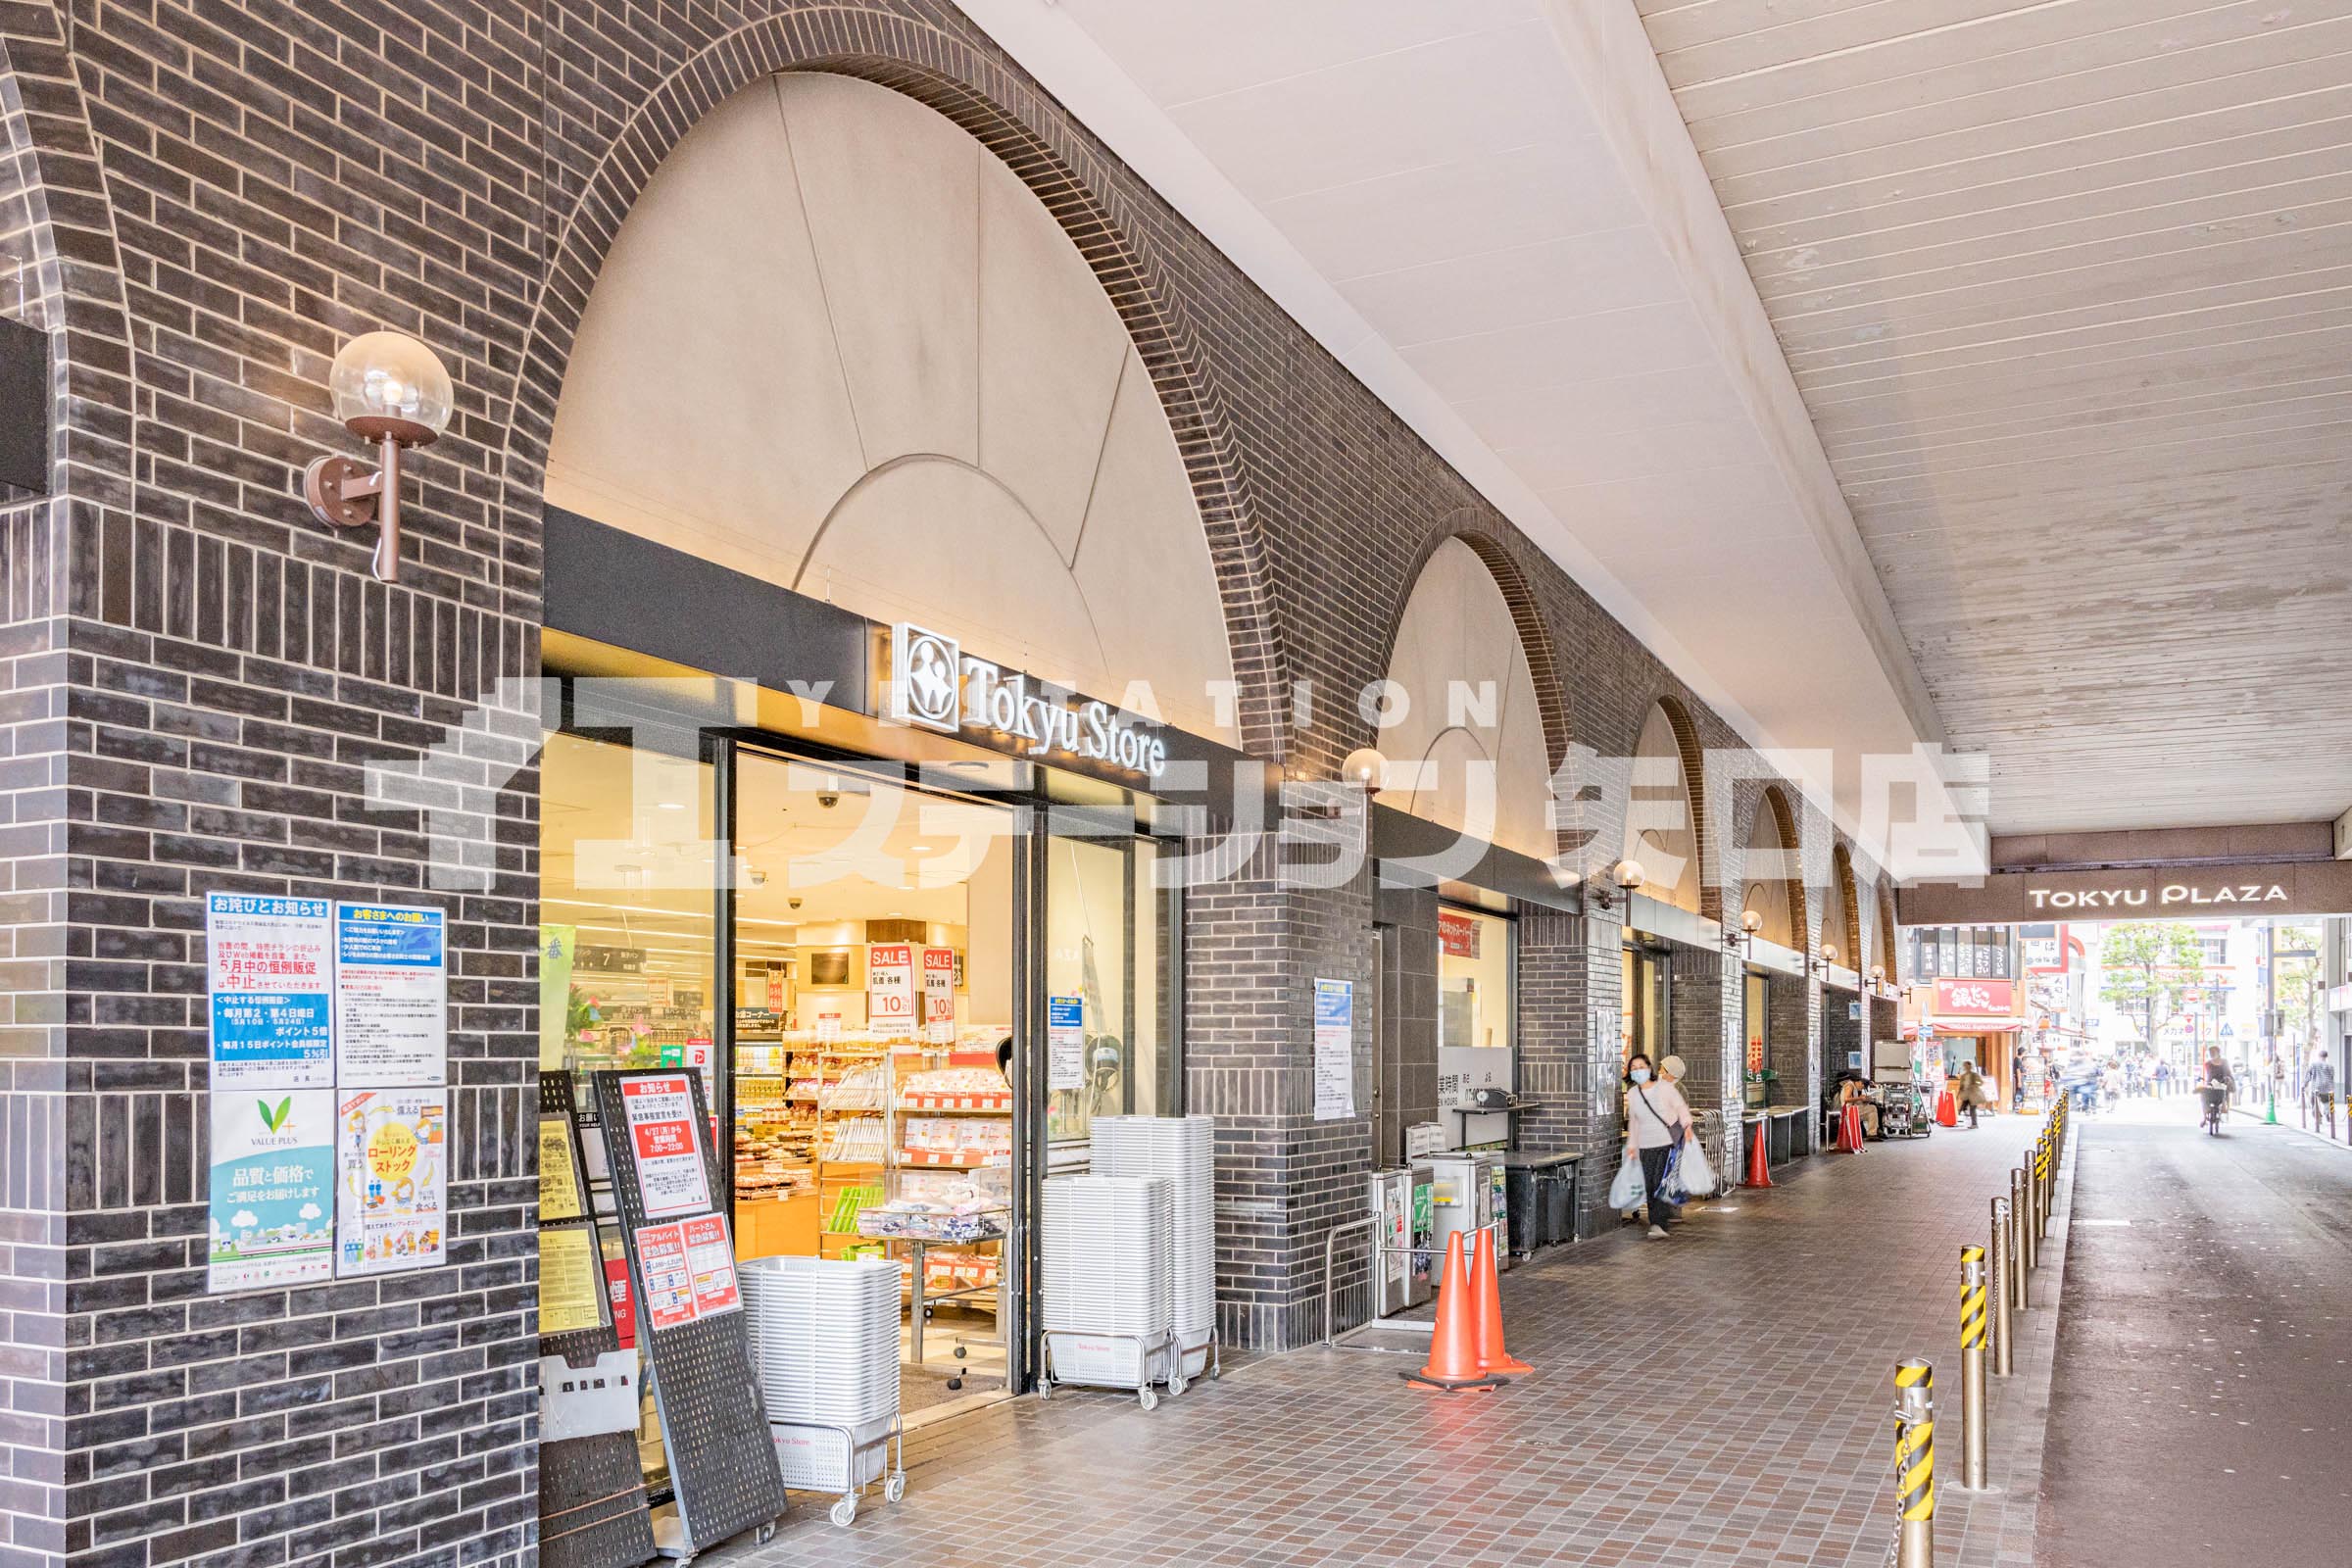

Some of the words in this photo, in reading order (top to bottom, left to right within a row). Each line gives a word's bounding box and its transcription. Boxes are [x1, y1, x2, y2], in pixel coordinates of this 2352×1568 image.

[961, 656, 1080, 755] Tokyu
[1080, 701, 1166, 777] Store
[2029, 889, 2148, 908] TOKYU
[2160, 884, 2288, 905] PLAZA
[214, 898, 324, 916] お詫びとお知らせ
[603, 954, 611, 966] 7
[872, 951, 908, 964] SALE
[925, 955, 951, 967] SALE
[640, 1082, 670, 1095] お知らせ
[251, 1137, 277, 1146] VALUE
[278, 1136, 298, 1146] PLUS
[368, 1144, 416, 1158] ローリング
[375, 1160, 411, 1173] ストック
[233, 1163, 315, 1188] 品質と価格で
[226, 1187, 320, 1203] ご満足をお届けします
[772, 1435, 791, 1445] okyu
